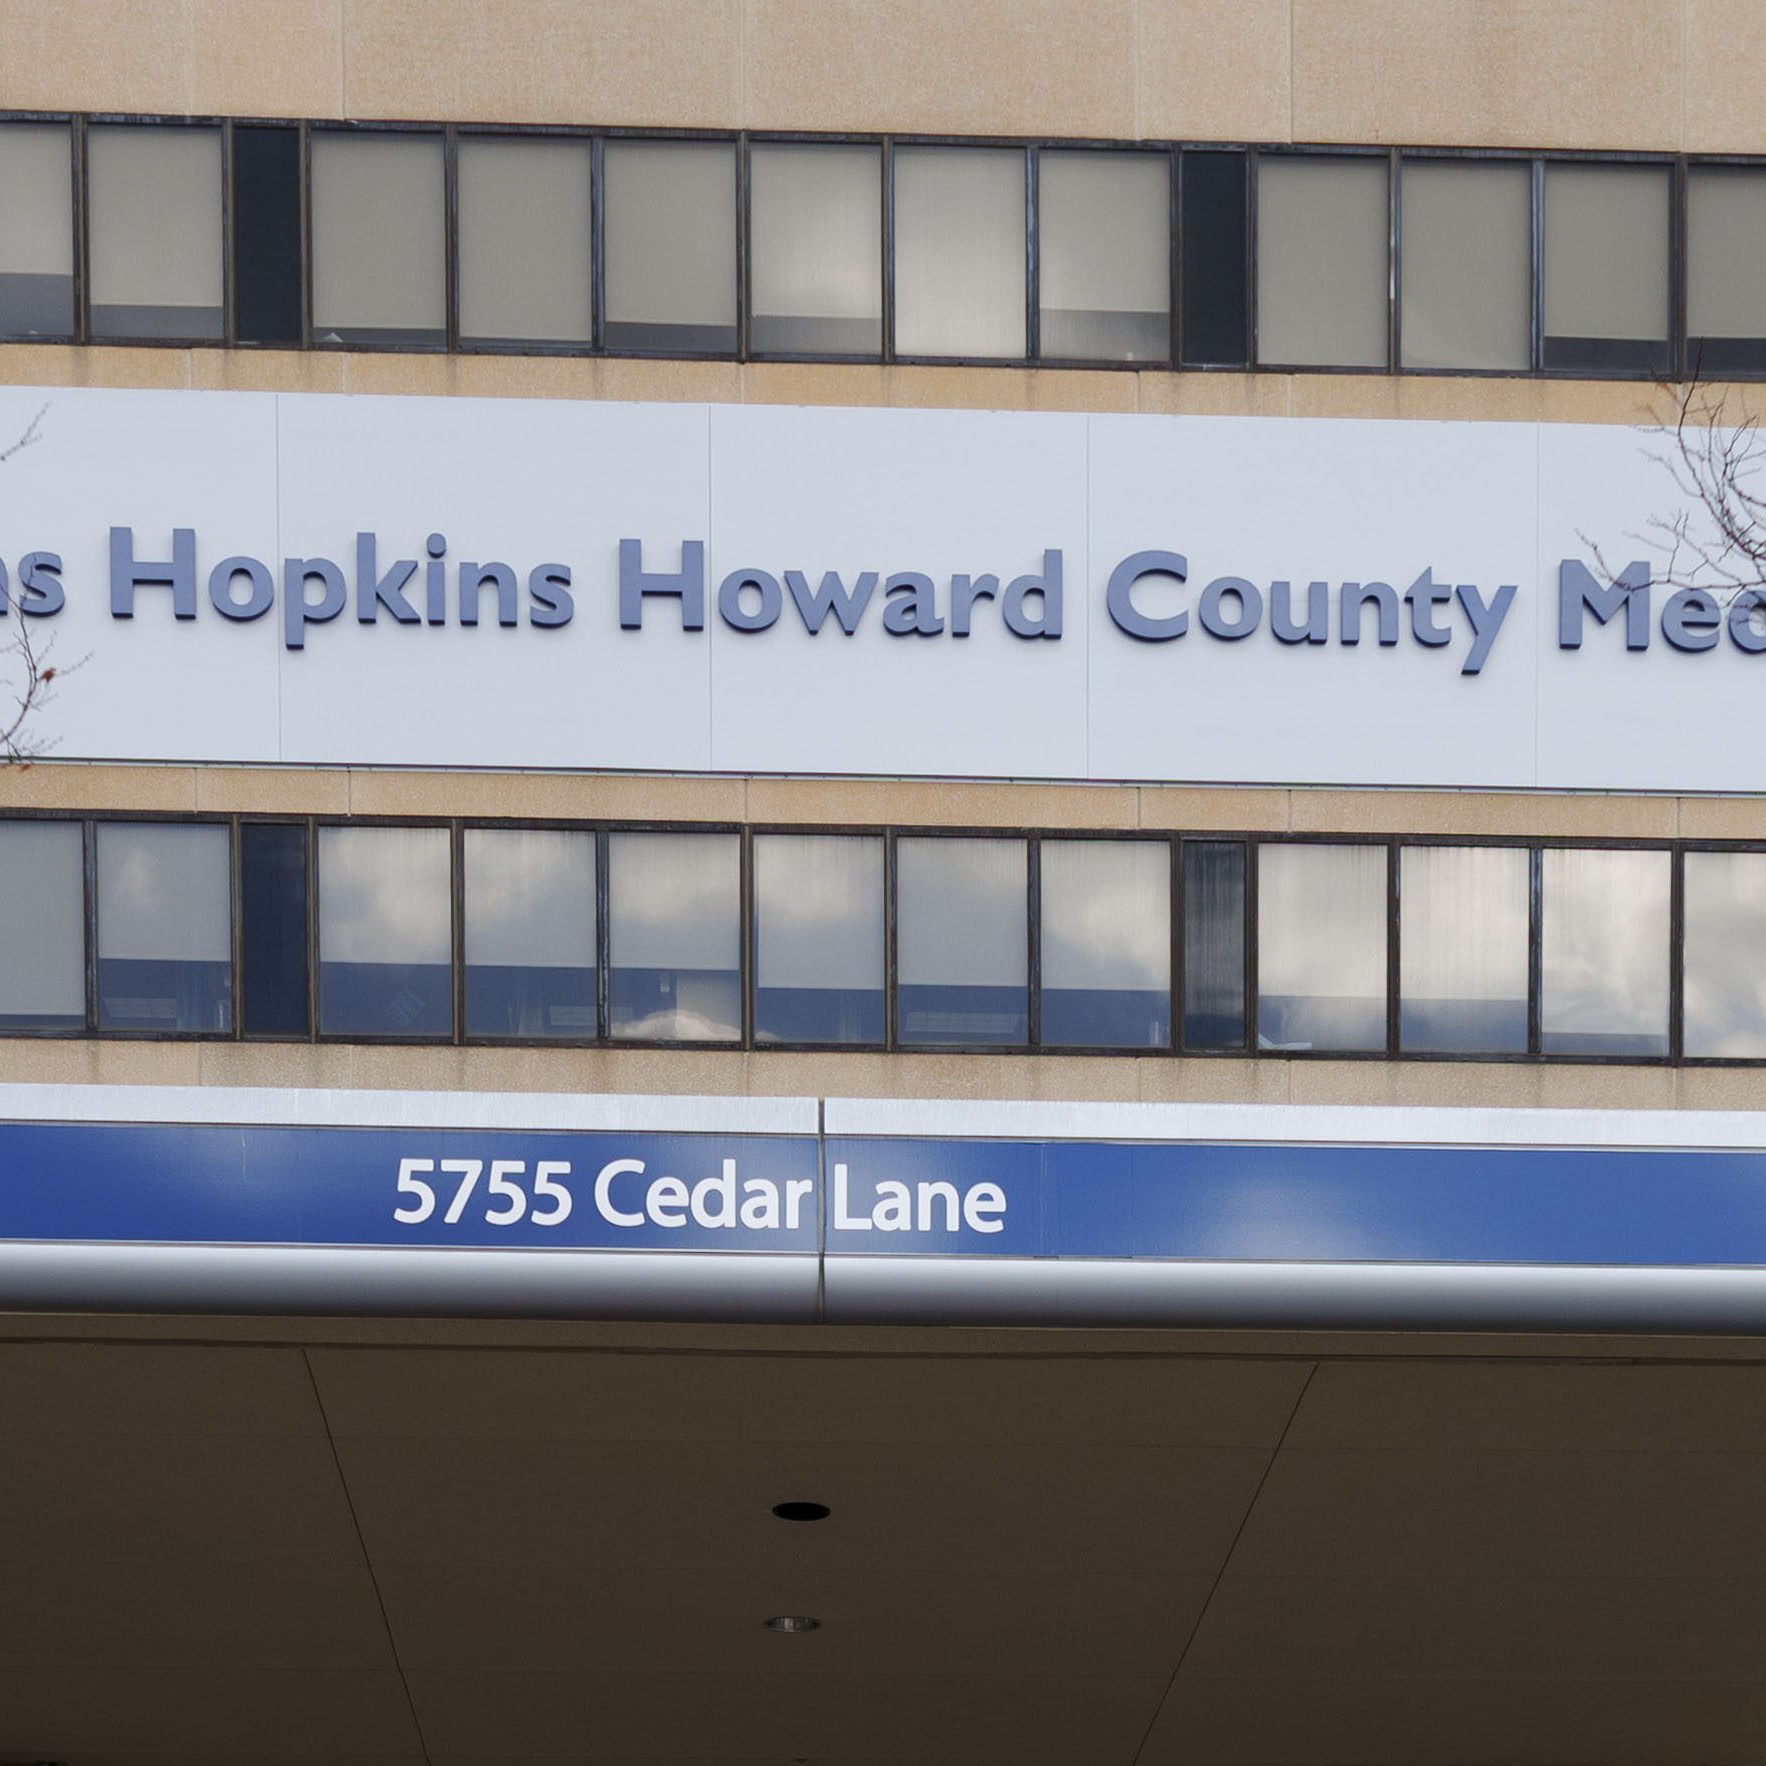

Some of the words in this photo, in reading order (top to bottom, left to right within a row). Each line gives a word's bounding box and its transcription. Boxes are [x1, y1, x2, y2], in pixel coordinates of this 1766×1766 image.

[109, 526, 575, 650] Hopkins
[619, 538, 1064, 640] Howard
[1106, 549, 1519, 675] County
[393, 1157, 574, 1227] 5755
[594, 1158, 813, 1231] Cedar
[833, 1162, 1008, 1235] Lane
